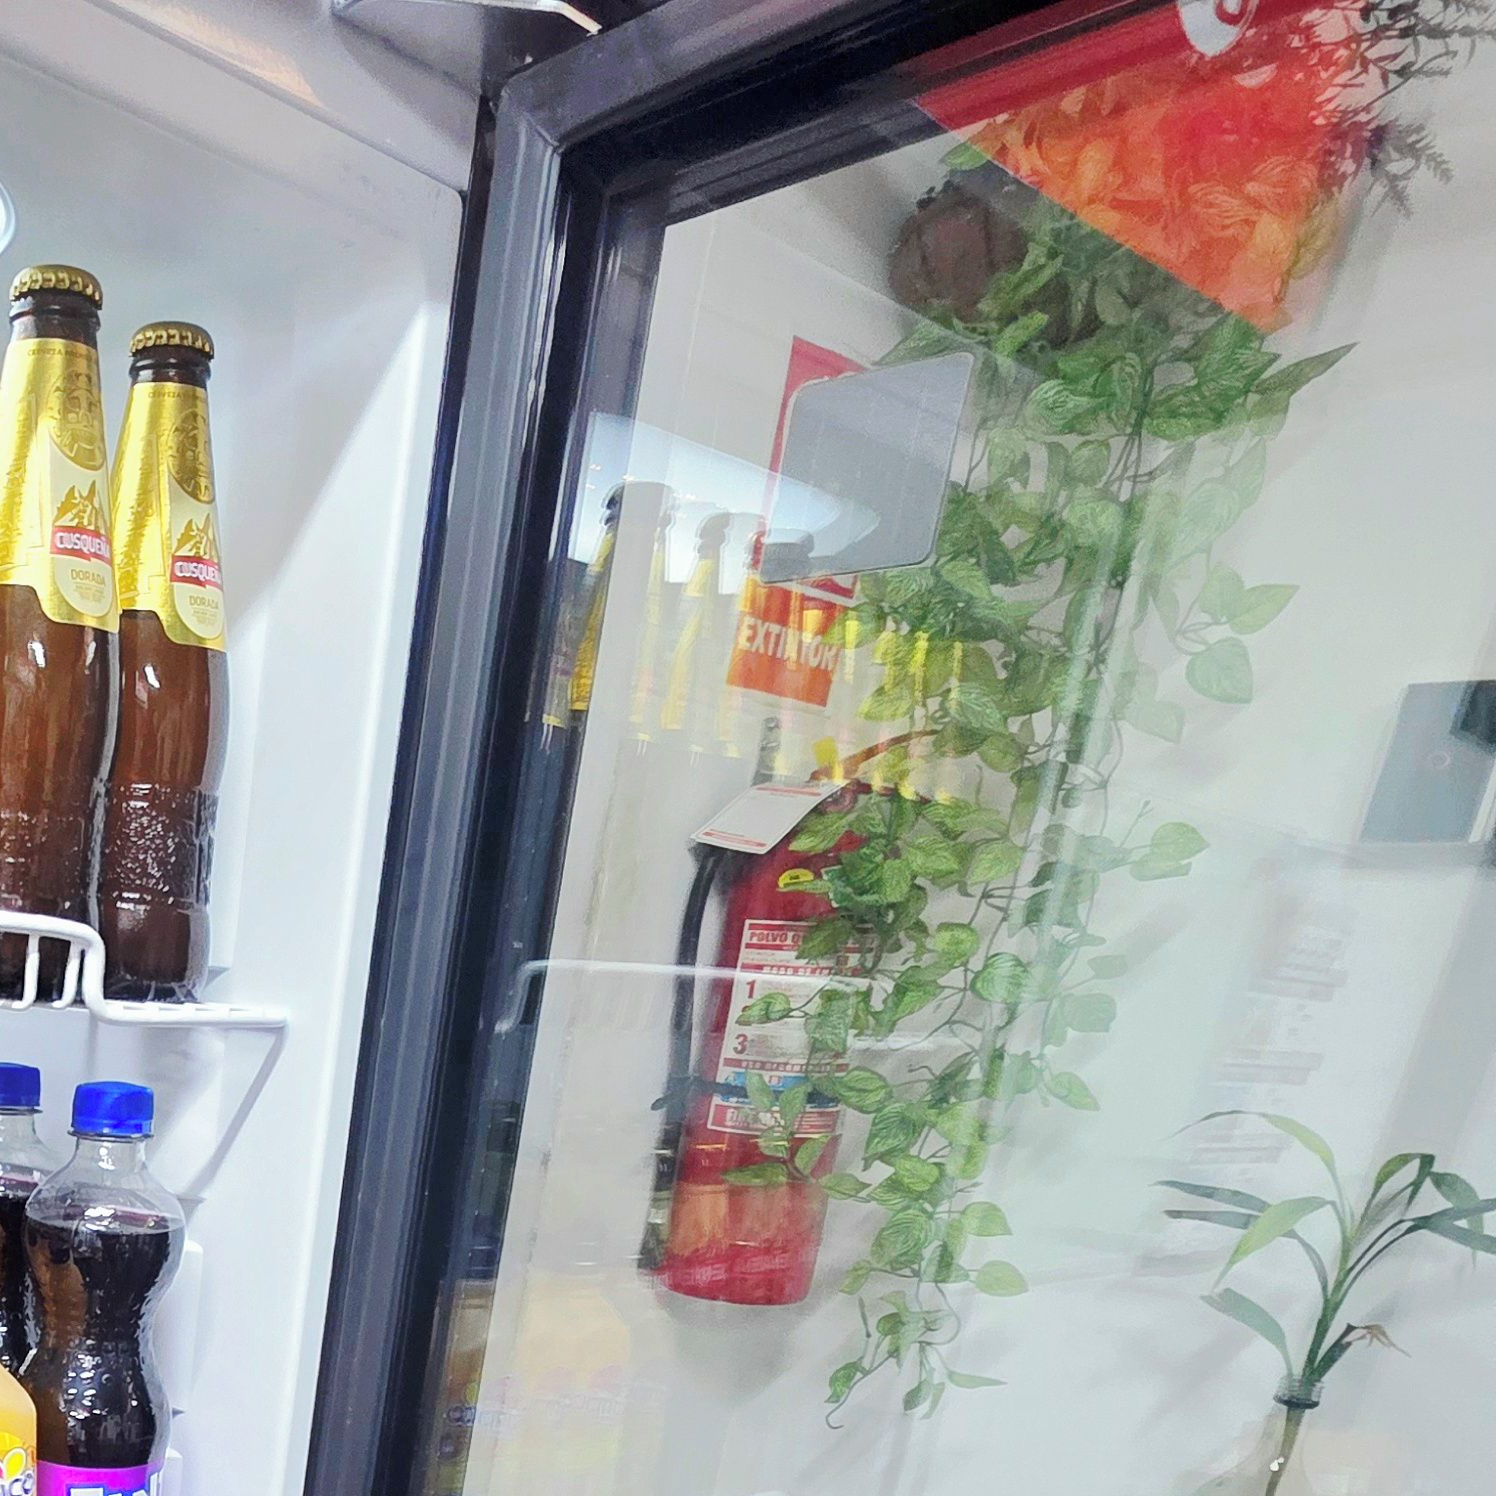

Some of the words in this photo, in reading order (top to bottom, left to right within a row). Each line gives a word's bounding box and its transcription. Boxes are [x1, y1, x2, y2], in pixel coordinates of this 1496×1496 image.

[70, 568, 105, 583] DORADA
[188, 595, 219, 610] DORADA
[746, 979, 756, 999] 1
[732, 1033, 748, 1055] 3
